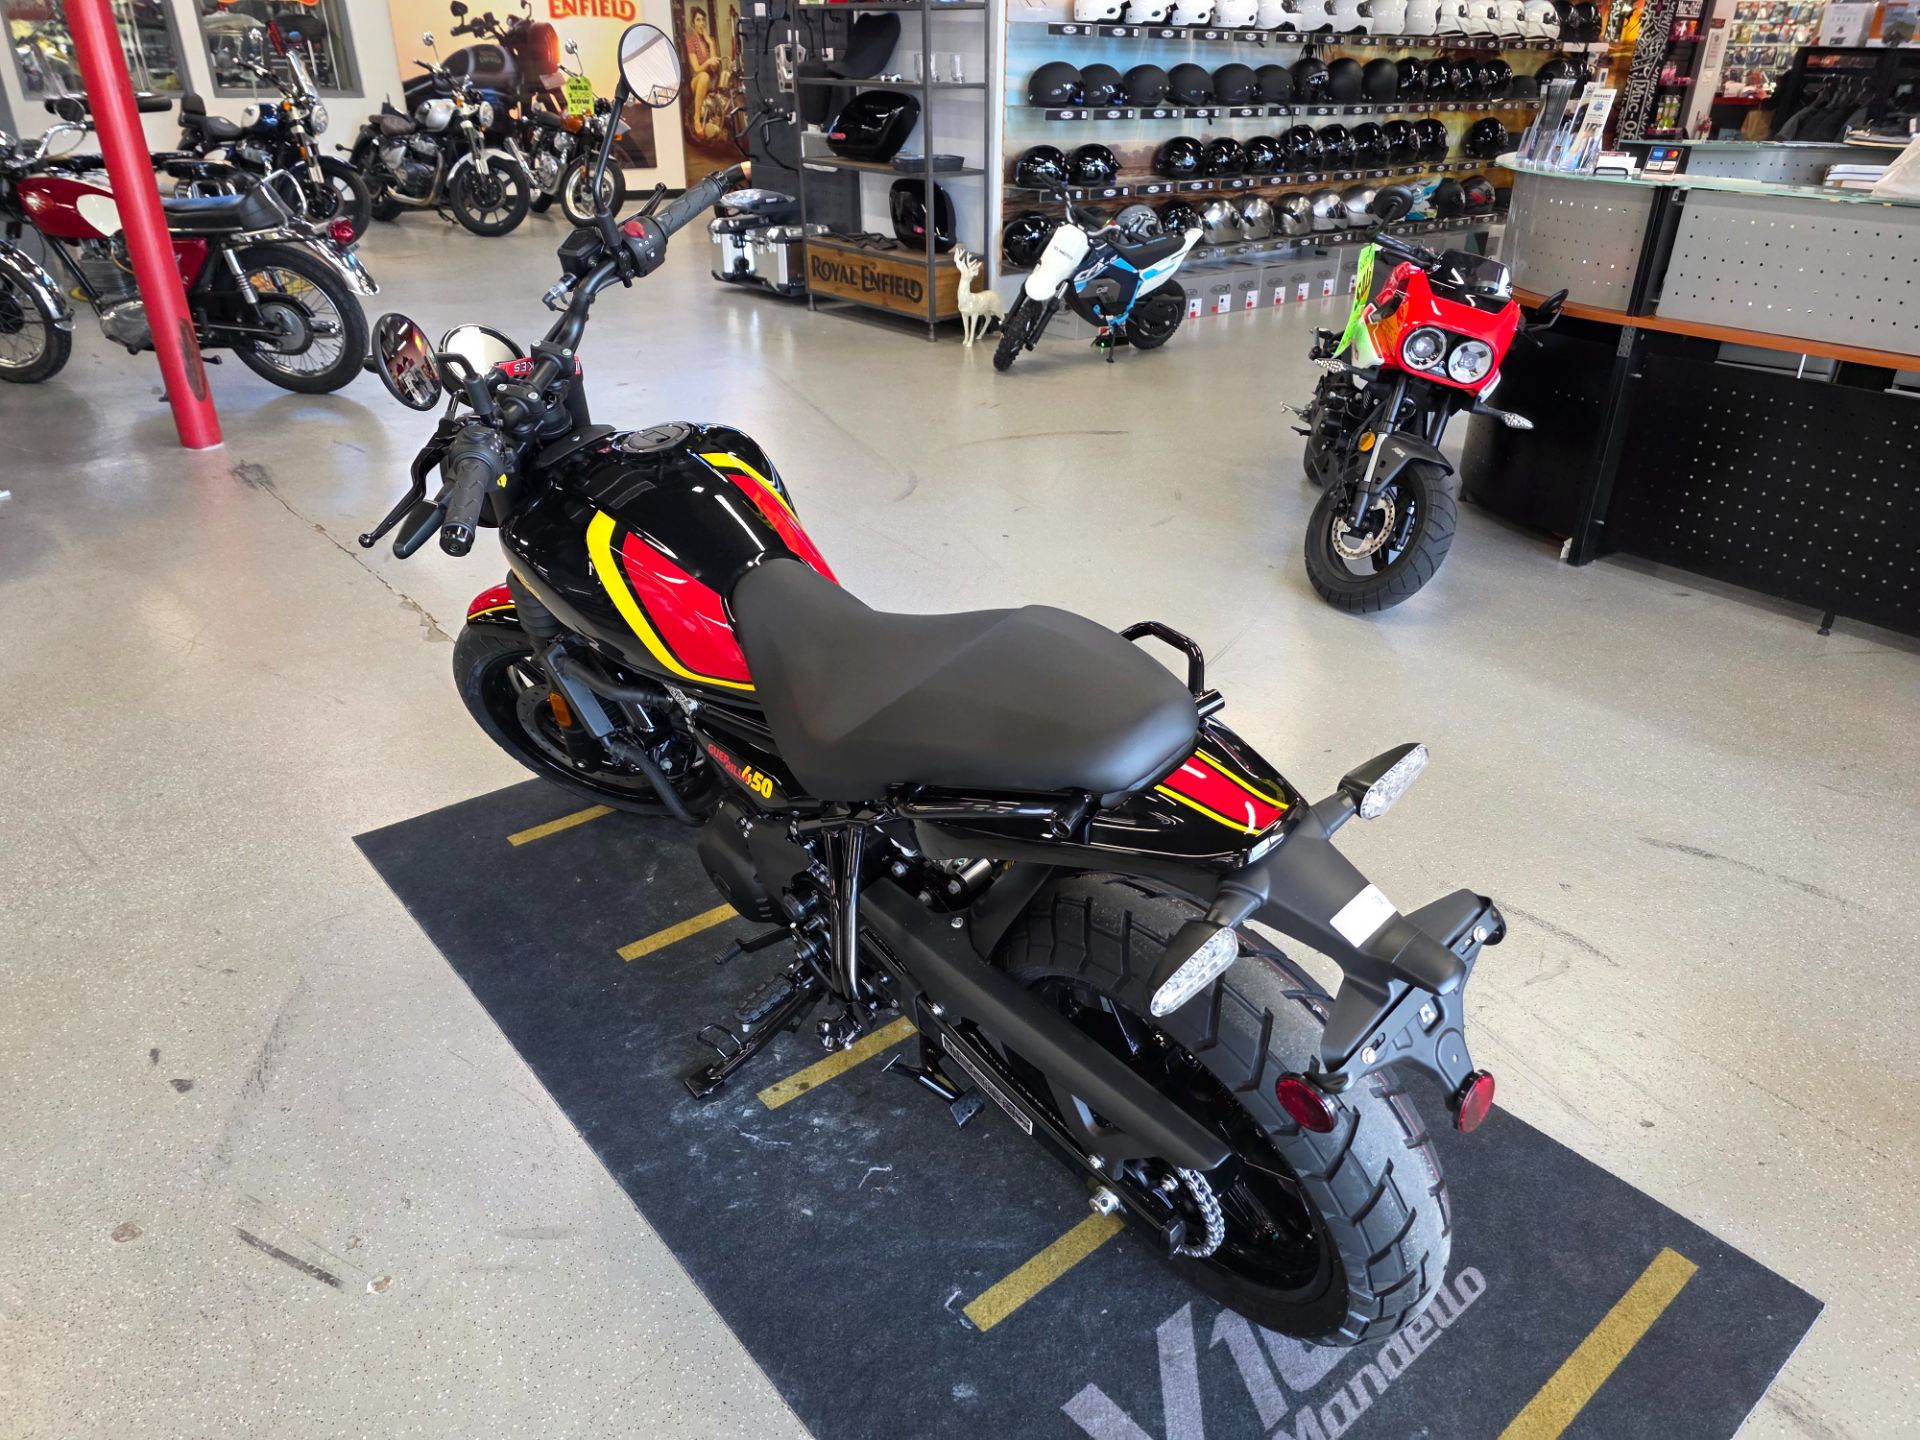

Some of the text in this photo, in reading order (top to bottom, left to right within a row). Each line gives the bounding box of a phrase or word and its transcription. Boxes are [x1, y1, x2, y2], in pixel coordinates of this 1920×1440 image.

[548, 0, 636, 21] ENFIELD
[811, 255, 923, 304] ROYAL ENFIELD
[741, 765, 773, 799] 450
